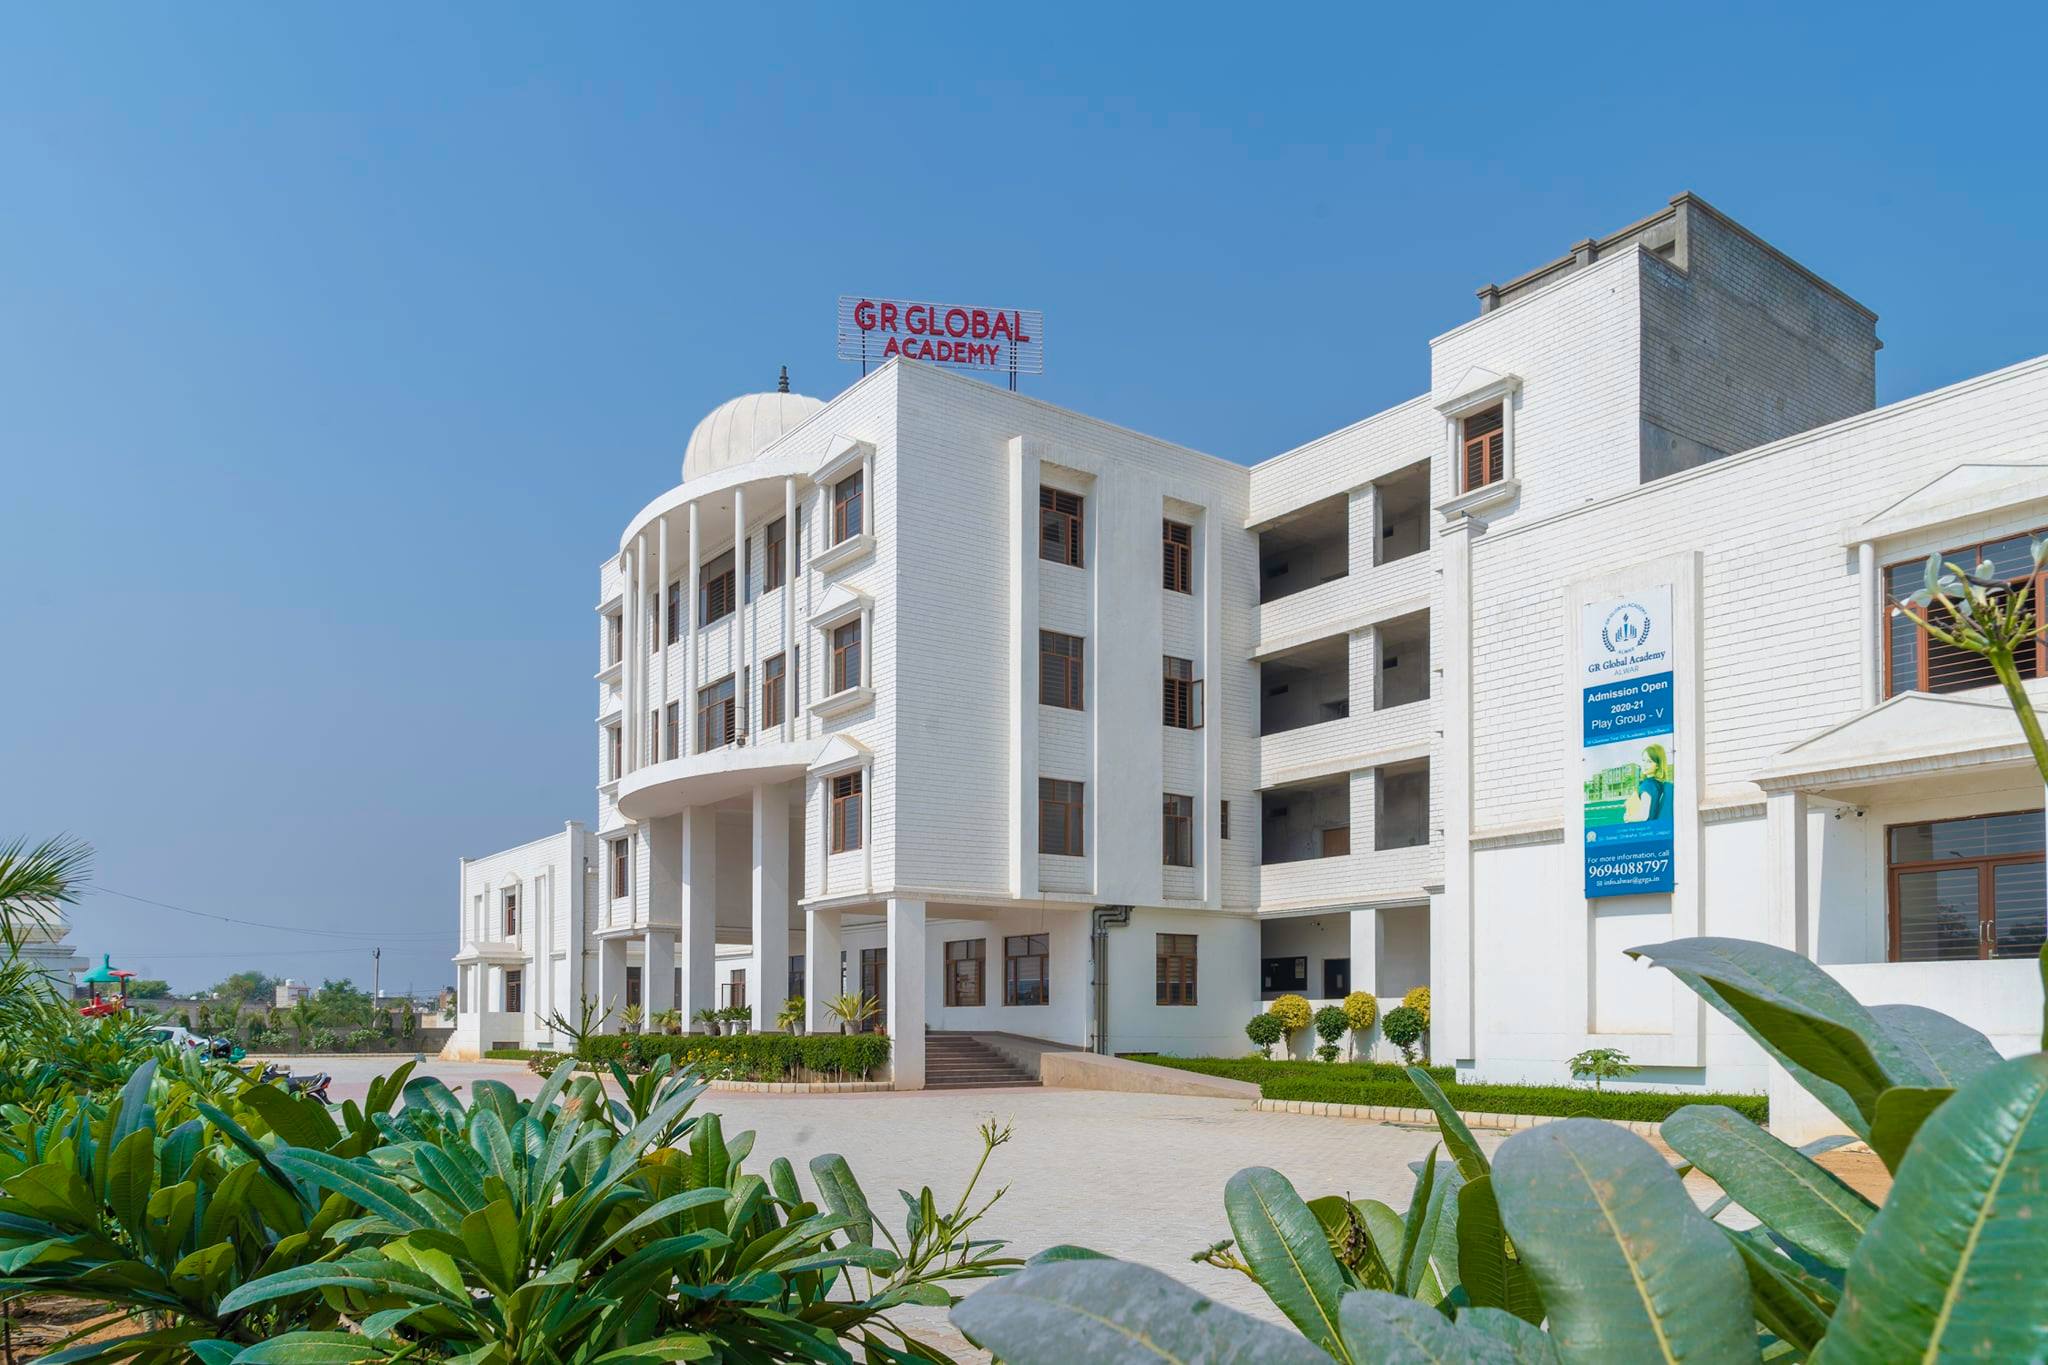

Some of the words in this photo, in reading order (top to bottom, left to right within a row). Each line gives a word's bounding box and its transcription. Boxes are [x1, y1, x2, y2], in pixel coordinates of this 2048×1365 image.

[854, 301, 898, 332] GR
[905, 305, 1030, 342] GLOBAL
[883, 336, 1000, 365] ACADEMY
[1588, 663, 1601, 673] GR
[1602, 656, 1628, 670] Global
[1629, 650, 1666, 665] Academy
[1614, 665, 1640, 676] ALWAR
[1587, 687, 1639, 703] Admission
[1641, 681, 1668, 693] Open
[1610, 700, 1644, 714] 2020-21
[1591, 719, 1613, 730] Play
[1615, 713, 1647, 726] Group
[1655, 707, 1664, 719] V
[1616, 852, 1657, 862] information,
[1658, 849, 1670, 857] call
[1589, 860, 1669, 878] 9694088797
